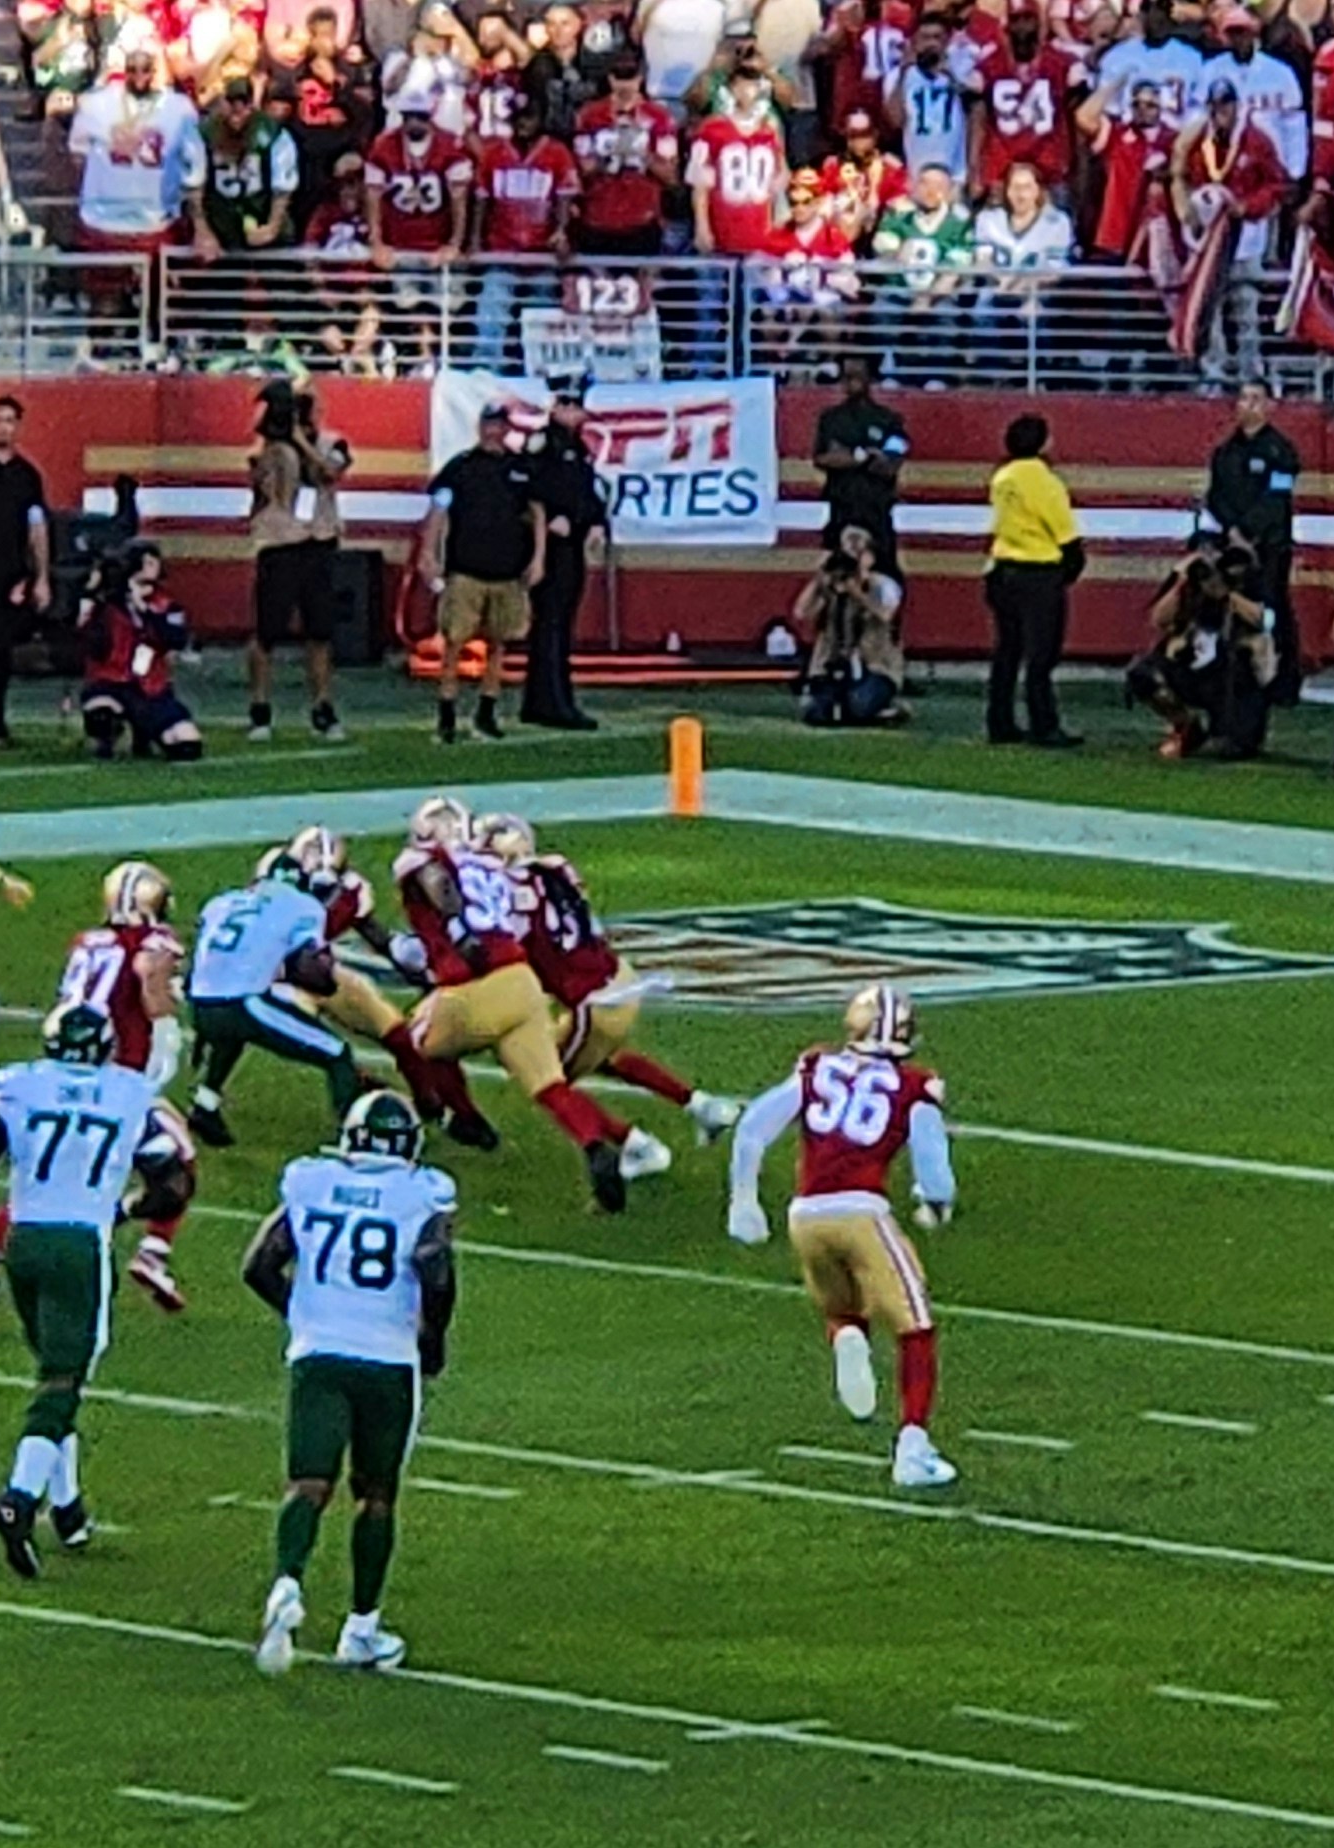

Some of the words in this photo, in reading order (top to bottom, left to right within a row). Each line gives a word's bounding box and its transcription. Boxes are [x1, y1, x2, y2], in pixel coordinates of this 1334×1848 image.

[913, 86, 954, 134] 17
[992, 79, 1054, 135] 54
[391, 174, 443, 214] 23
[720, 143, 774, 203] 80
[575, 277, 640, 313] 123
[593, 467, 759, 517] RTES
[210, 906, 261, 952] 5
[60, 945, 126, 1012] 97
[806, 1053, 901, 1146] 56
[26, 1108, 124, 1188] 77
[302, 1208, 397, 1291] 78
